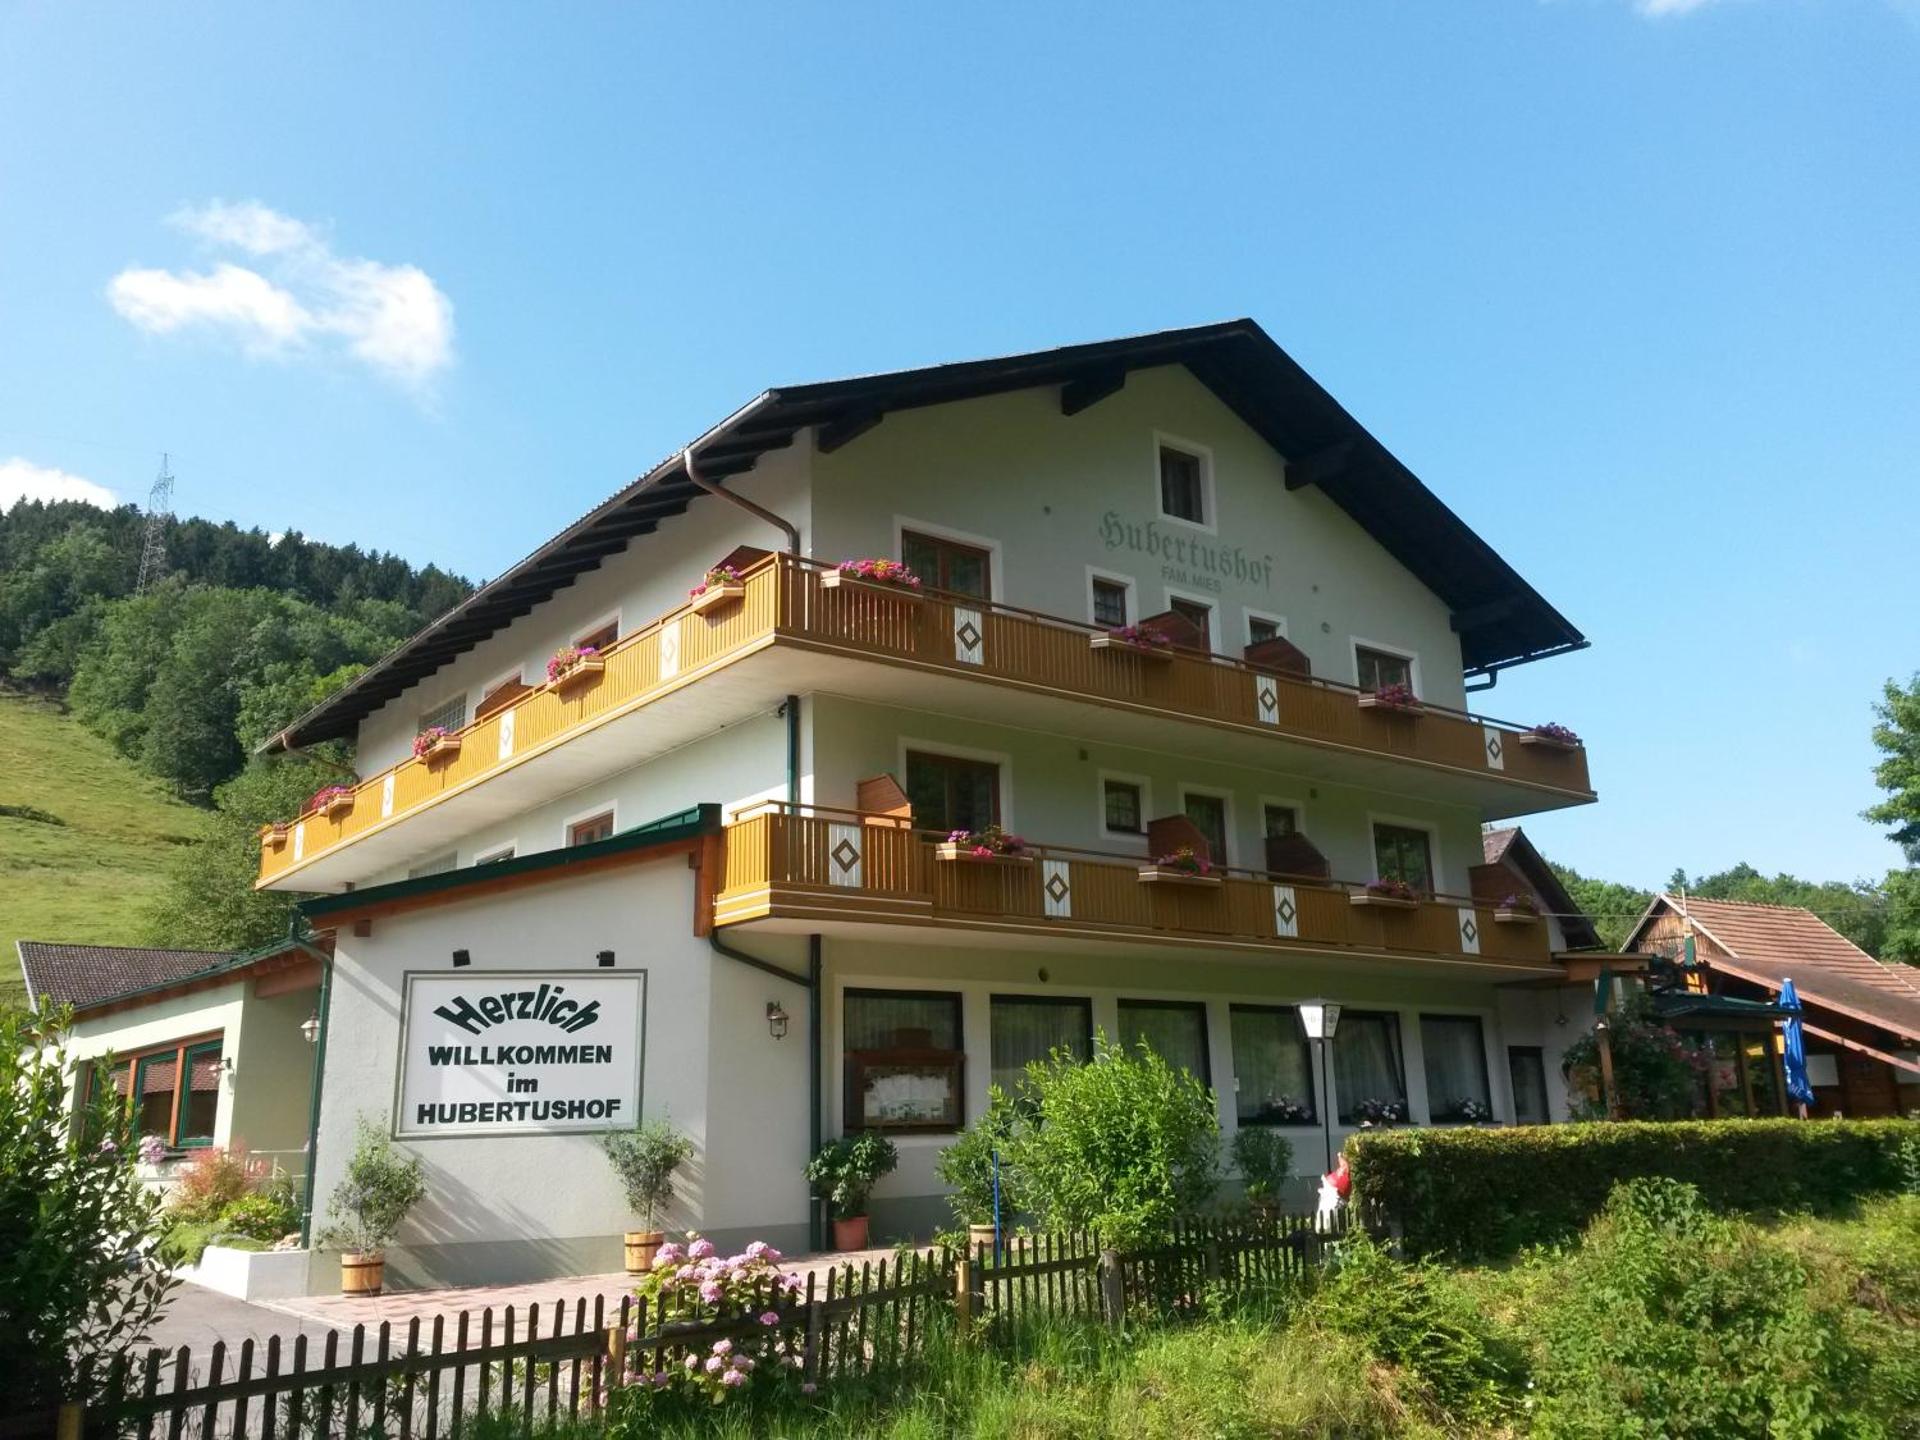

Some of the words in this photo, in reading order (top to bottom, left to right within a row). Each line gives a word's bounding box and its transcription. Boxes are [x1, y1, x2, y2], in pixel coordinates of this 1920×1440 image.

[433, 984, 601, 1035] Herzlich
[428, 1045, 613, 1066] WILLKOMMEN
[507, 1072, 538, 1093] im
[417, 1100, 621, 1124] HUBERTUSHOF
